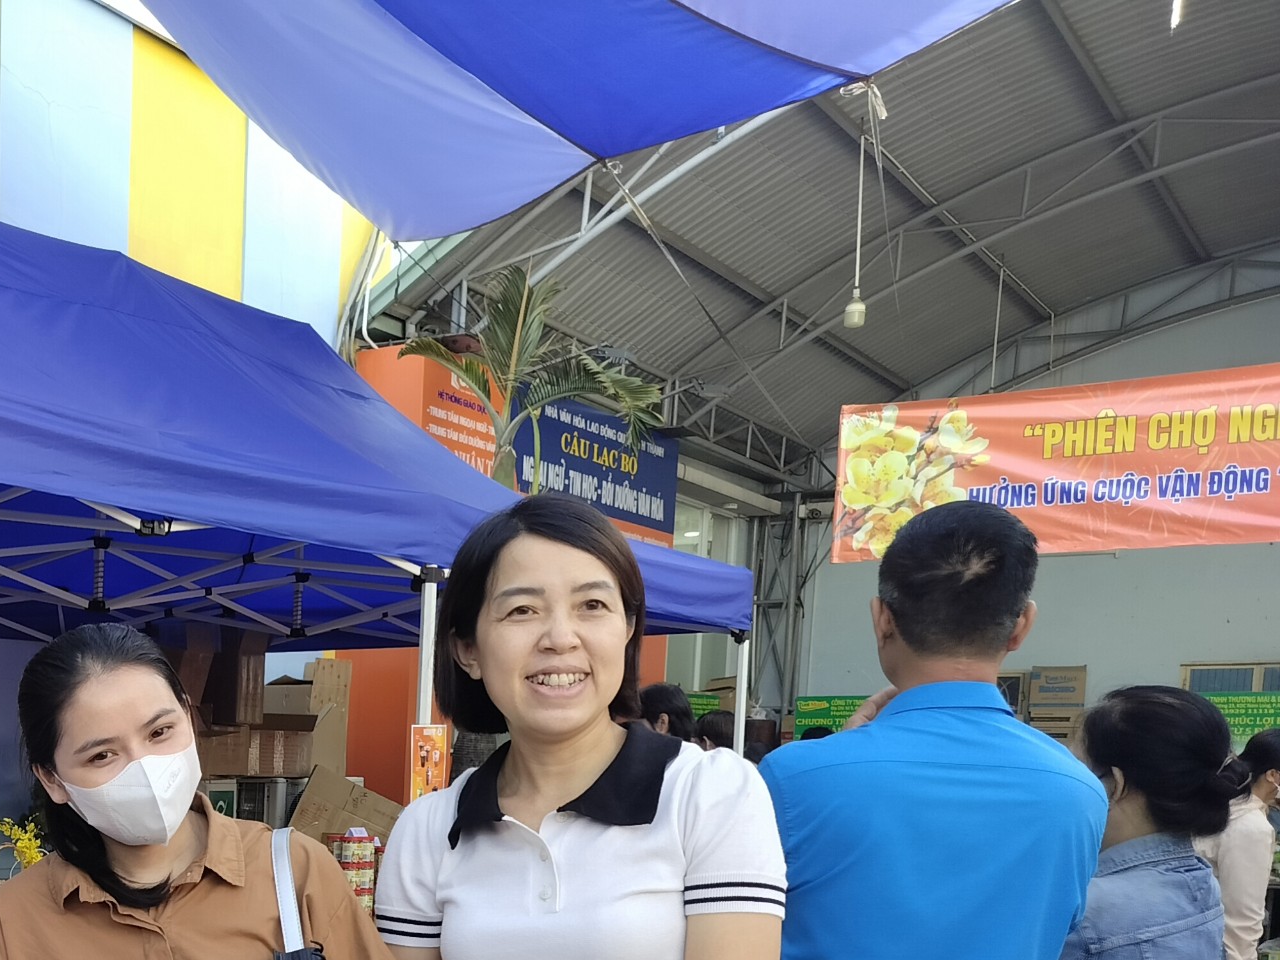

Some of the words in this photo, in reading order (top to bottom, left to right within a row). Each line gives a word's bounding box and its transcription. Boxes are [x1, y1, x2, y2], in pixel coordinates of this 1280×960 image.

[544, 404, 558, 420] NHÀ
[559, 407, 572, 424] VĂN
[572, 413, 586, 430] HÓA
[586, 420, 600, 435] LAO
[600, 424, 617, 441] ĐỘNG
[1147, 404, 1218, 459] CHỢ
[1228, 402, 1280, 446] NG
[561, 431, 590, 459] CÂU
[592, 443, 618, 471] LẠC
[522, 455, 547, 490] NGẠI
[569, 469, 582, 495] TIN
[582, 474, 598, 504] HỌC
[638, 487, 651, 517] VĂN
[967, 480, 1037, 511] HƯỞNG
[1042, 477, 1088, 507] ỨNG
[1092, 472, 1150, 508] CUỘC
[1156, 468, 1203, 504] VẬN
[1207, 464, 1270, 500] ĐỘNG
